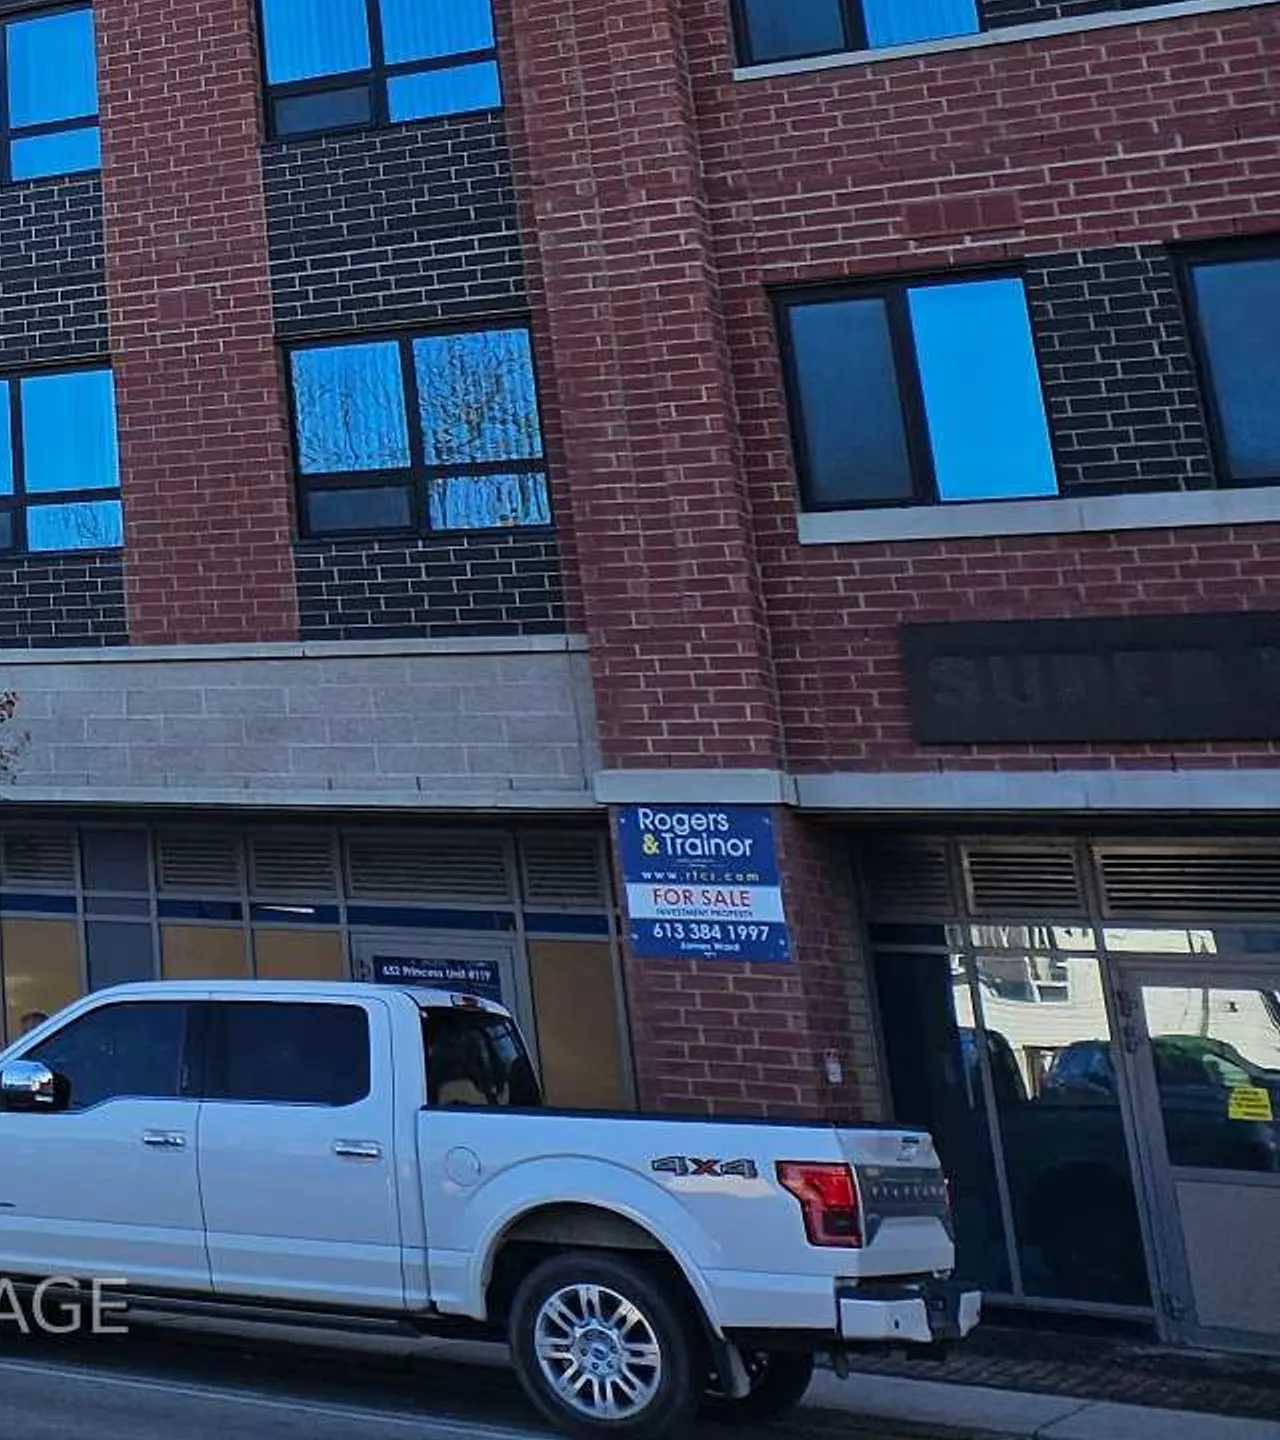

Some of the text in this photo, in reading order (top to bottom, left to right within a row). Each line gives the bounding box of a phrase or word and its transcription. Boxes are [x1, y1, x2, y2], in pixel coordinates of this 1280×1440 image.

[638, 807, 730, 836] Rogers
[642, 832, 754, 857] & Trainor
[653, 888, 752, 908] FOR SALE
[653, 922, 770, 942] 613 384 1997
